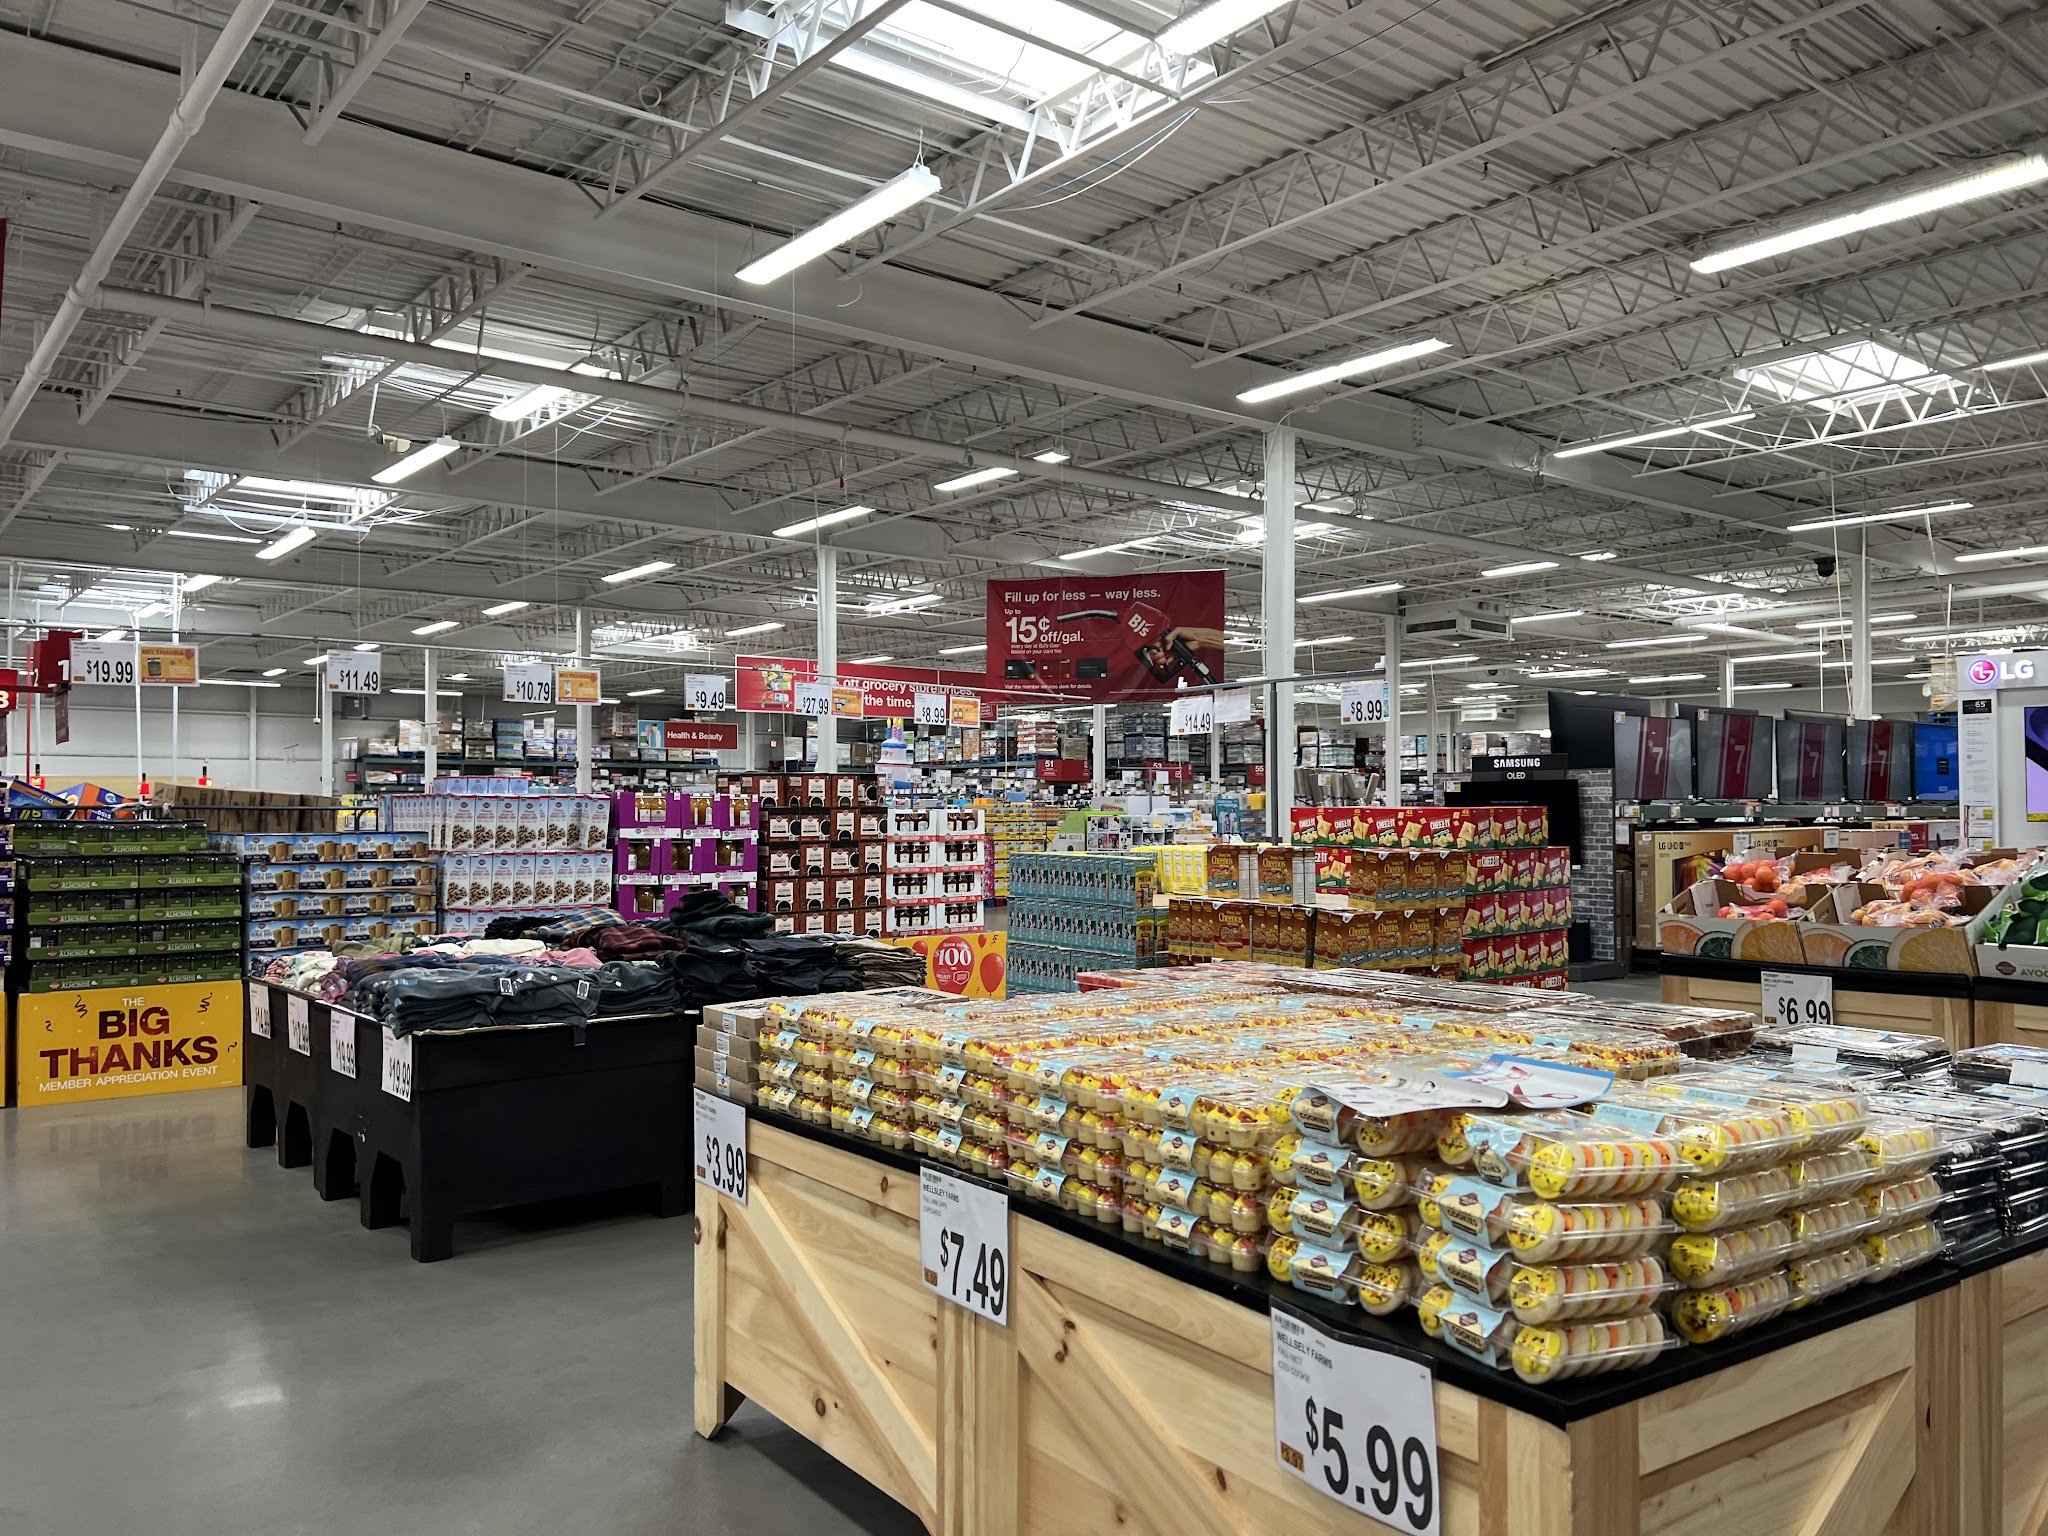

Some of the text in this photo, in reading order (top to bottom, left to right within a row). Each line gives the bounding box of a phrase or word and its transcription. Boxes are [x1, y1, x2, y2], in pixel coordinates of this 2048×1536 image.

[1004, 592, 1022, 602] Fill
[1024, 594, 1040, 604] up
[1042, 591, 1059, 601] for
[1062, 590, 1086, 600] less
[1105, 590, 1130, 601] way
[1132, 588, 1161, 598] less.
[1005, 616, 1050, 643] 15¢
[1040, 630, 1084, 644] off/gal.
[58, 660, 69, 681] 1
[87, 659, 133, 684] $19.99
[2000, 660, 2034, 680] LG
[340, 670, 378, 692] $11.49
[516, 680, 550, 701] $10.79
[863, 680, 906, 694] grocery
[696, 691, 724, 709] $9.49
[803, 697, 829, 715] $27.99
[864, 695, 883, 706] the
[886, 696, 914, 708] time.
[922, 707, 945, 723] $8.99
[1351, 700, 1382, 722] $8.99
[1185, 712, 1211, 733] $14.49
[667, 731, 690, 740] Health
[698, 732, 724, 742] Beauty
[1494, 758, 1540, 768] SAMSUNG
[60, 915, 89, 923] ALMONDS
[59, 949, 88, 957] ALMONDS
[934, 948, 972, 966] $100
[61, 980, 90, 989] ALMONDS
[122, 997, 144, 1006] THE
[98, 1006, 170, 1040] BIG
[40, 1036, 218, 1079] THANKS
[39, 1066, 218, 1092] MEMBER APPRECIATION EVENT
[390, 1058, 410, 1098] $19.99
[1300, 1112, 1329, 1125] COOKIES
[706, 1133, 744, 1198] $3.99
[923, 1184, 959, 1203] WELLSLEY FARMS
[940, 1226, 1005, 1316] $7.49
[1277, 1331, 1310, 1355] WELLSELY
[1311, 1349, 1332, 1369] FARMS
[1305, 1396, 1433, 1530] $5.99
